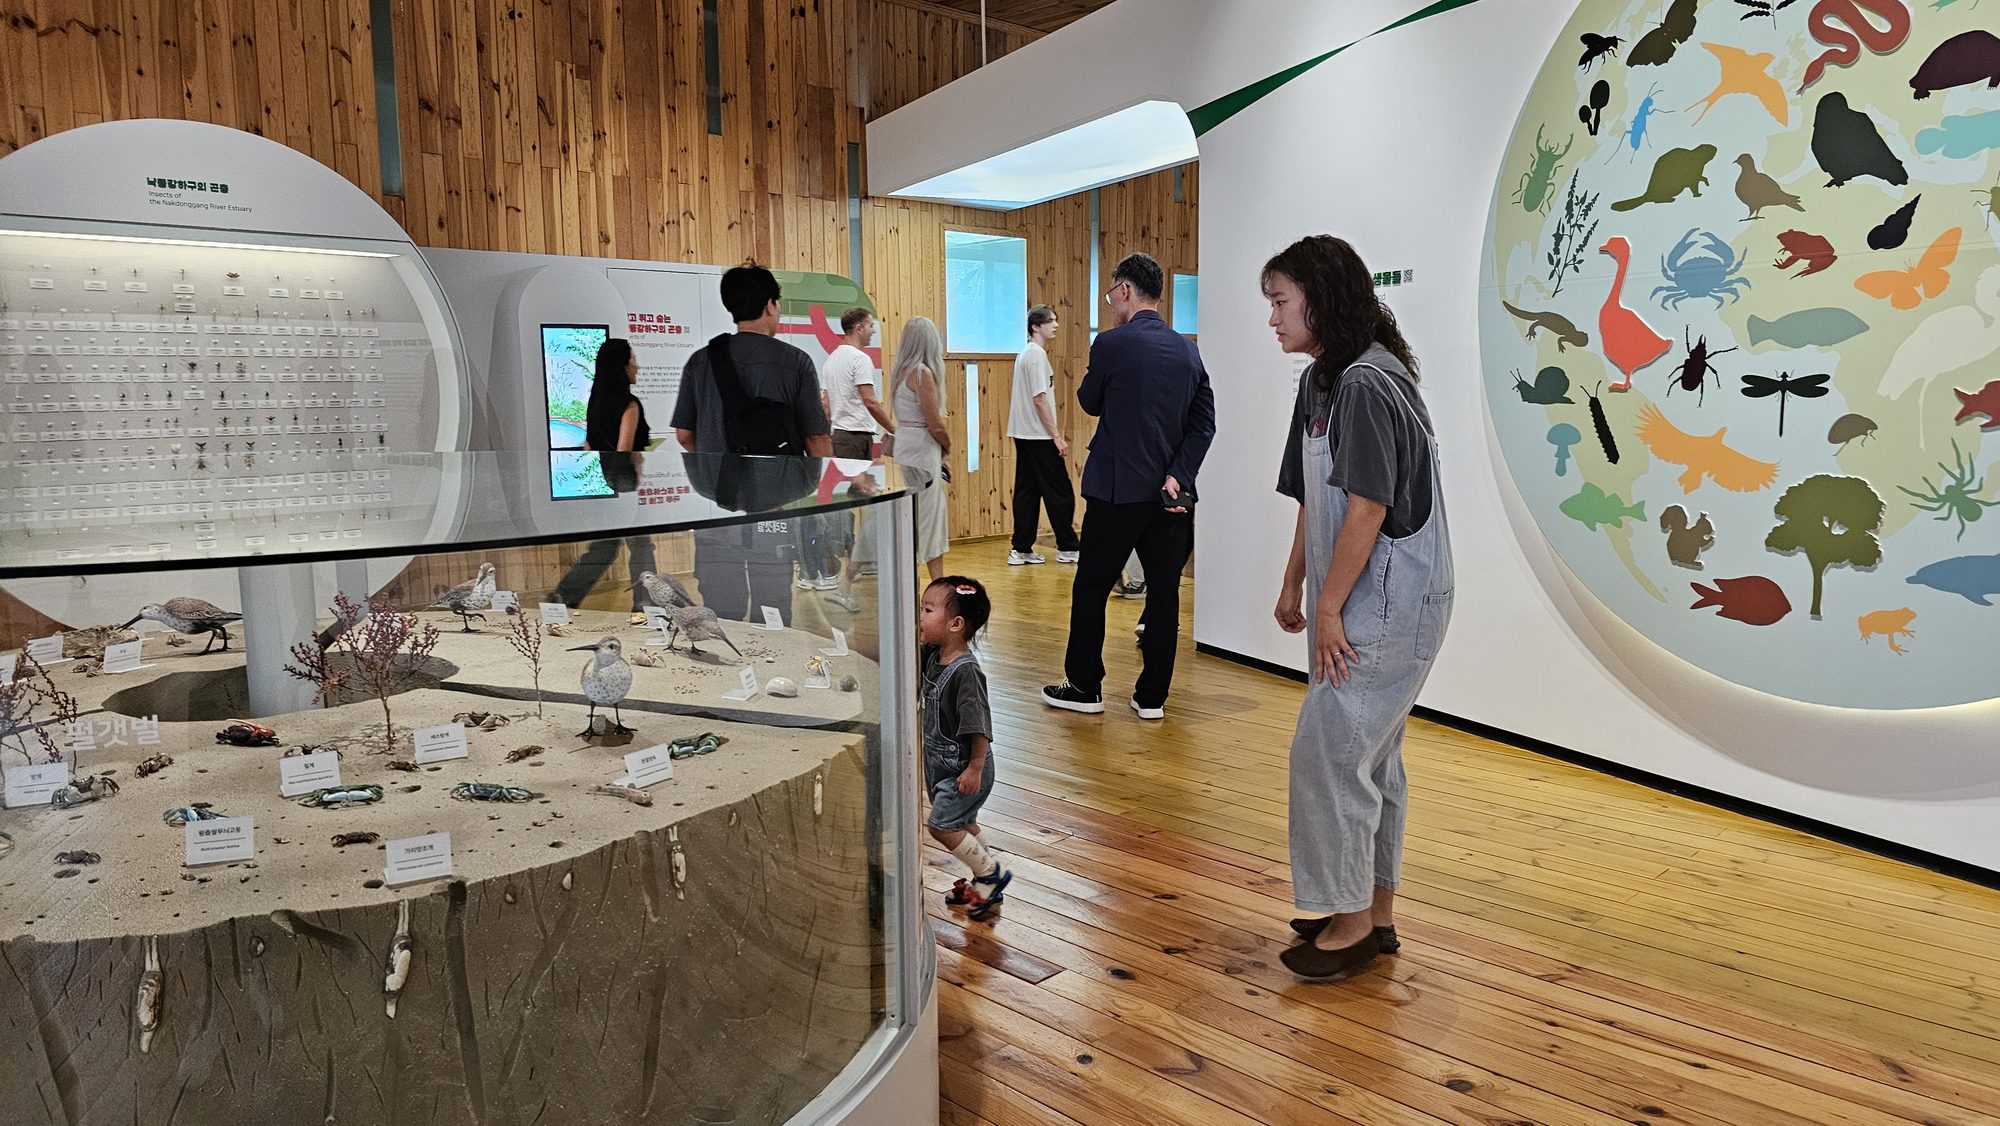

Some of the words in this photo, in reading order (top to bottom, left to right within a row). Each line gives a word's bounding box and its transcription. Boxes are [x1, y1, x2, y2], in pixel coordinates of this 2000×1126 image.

[146, 177, 207, 191] 낙동강하구의
[209, 182, 229, 193] 곤충
[148, 190, 173, 198] Insects
[162, 200, 209, 209] Nakdonggang
[627, 313, 637, 322] 고
[628, 324, 666, 334] 동강하구의
